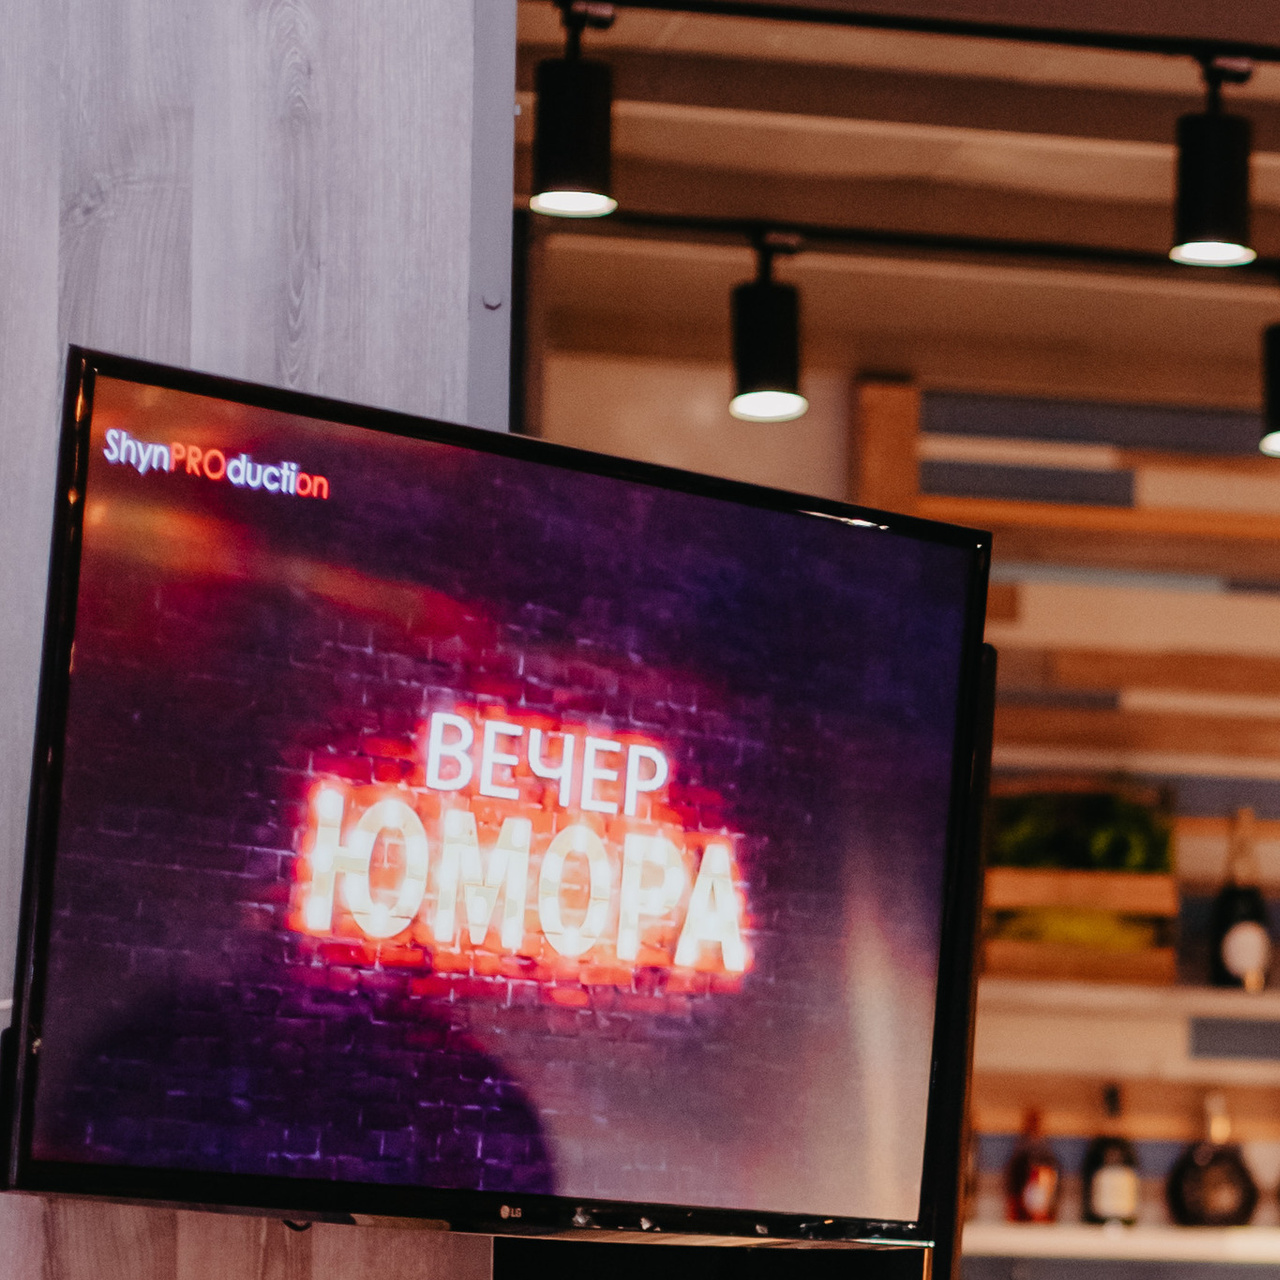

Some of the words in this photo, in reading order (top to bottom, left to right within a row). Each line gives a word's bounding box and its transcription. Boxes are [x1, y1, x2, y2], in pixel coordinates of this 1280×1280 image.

[103, 428, 330, 499] ShynPROduction
[425, 711, 670, 817] ВЕЧЕР
[303, 788, 746, 972] ЮМОРА
